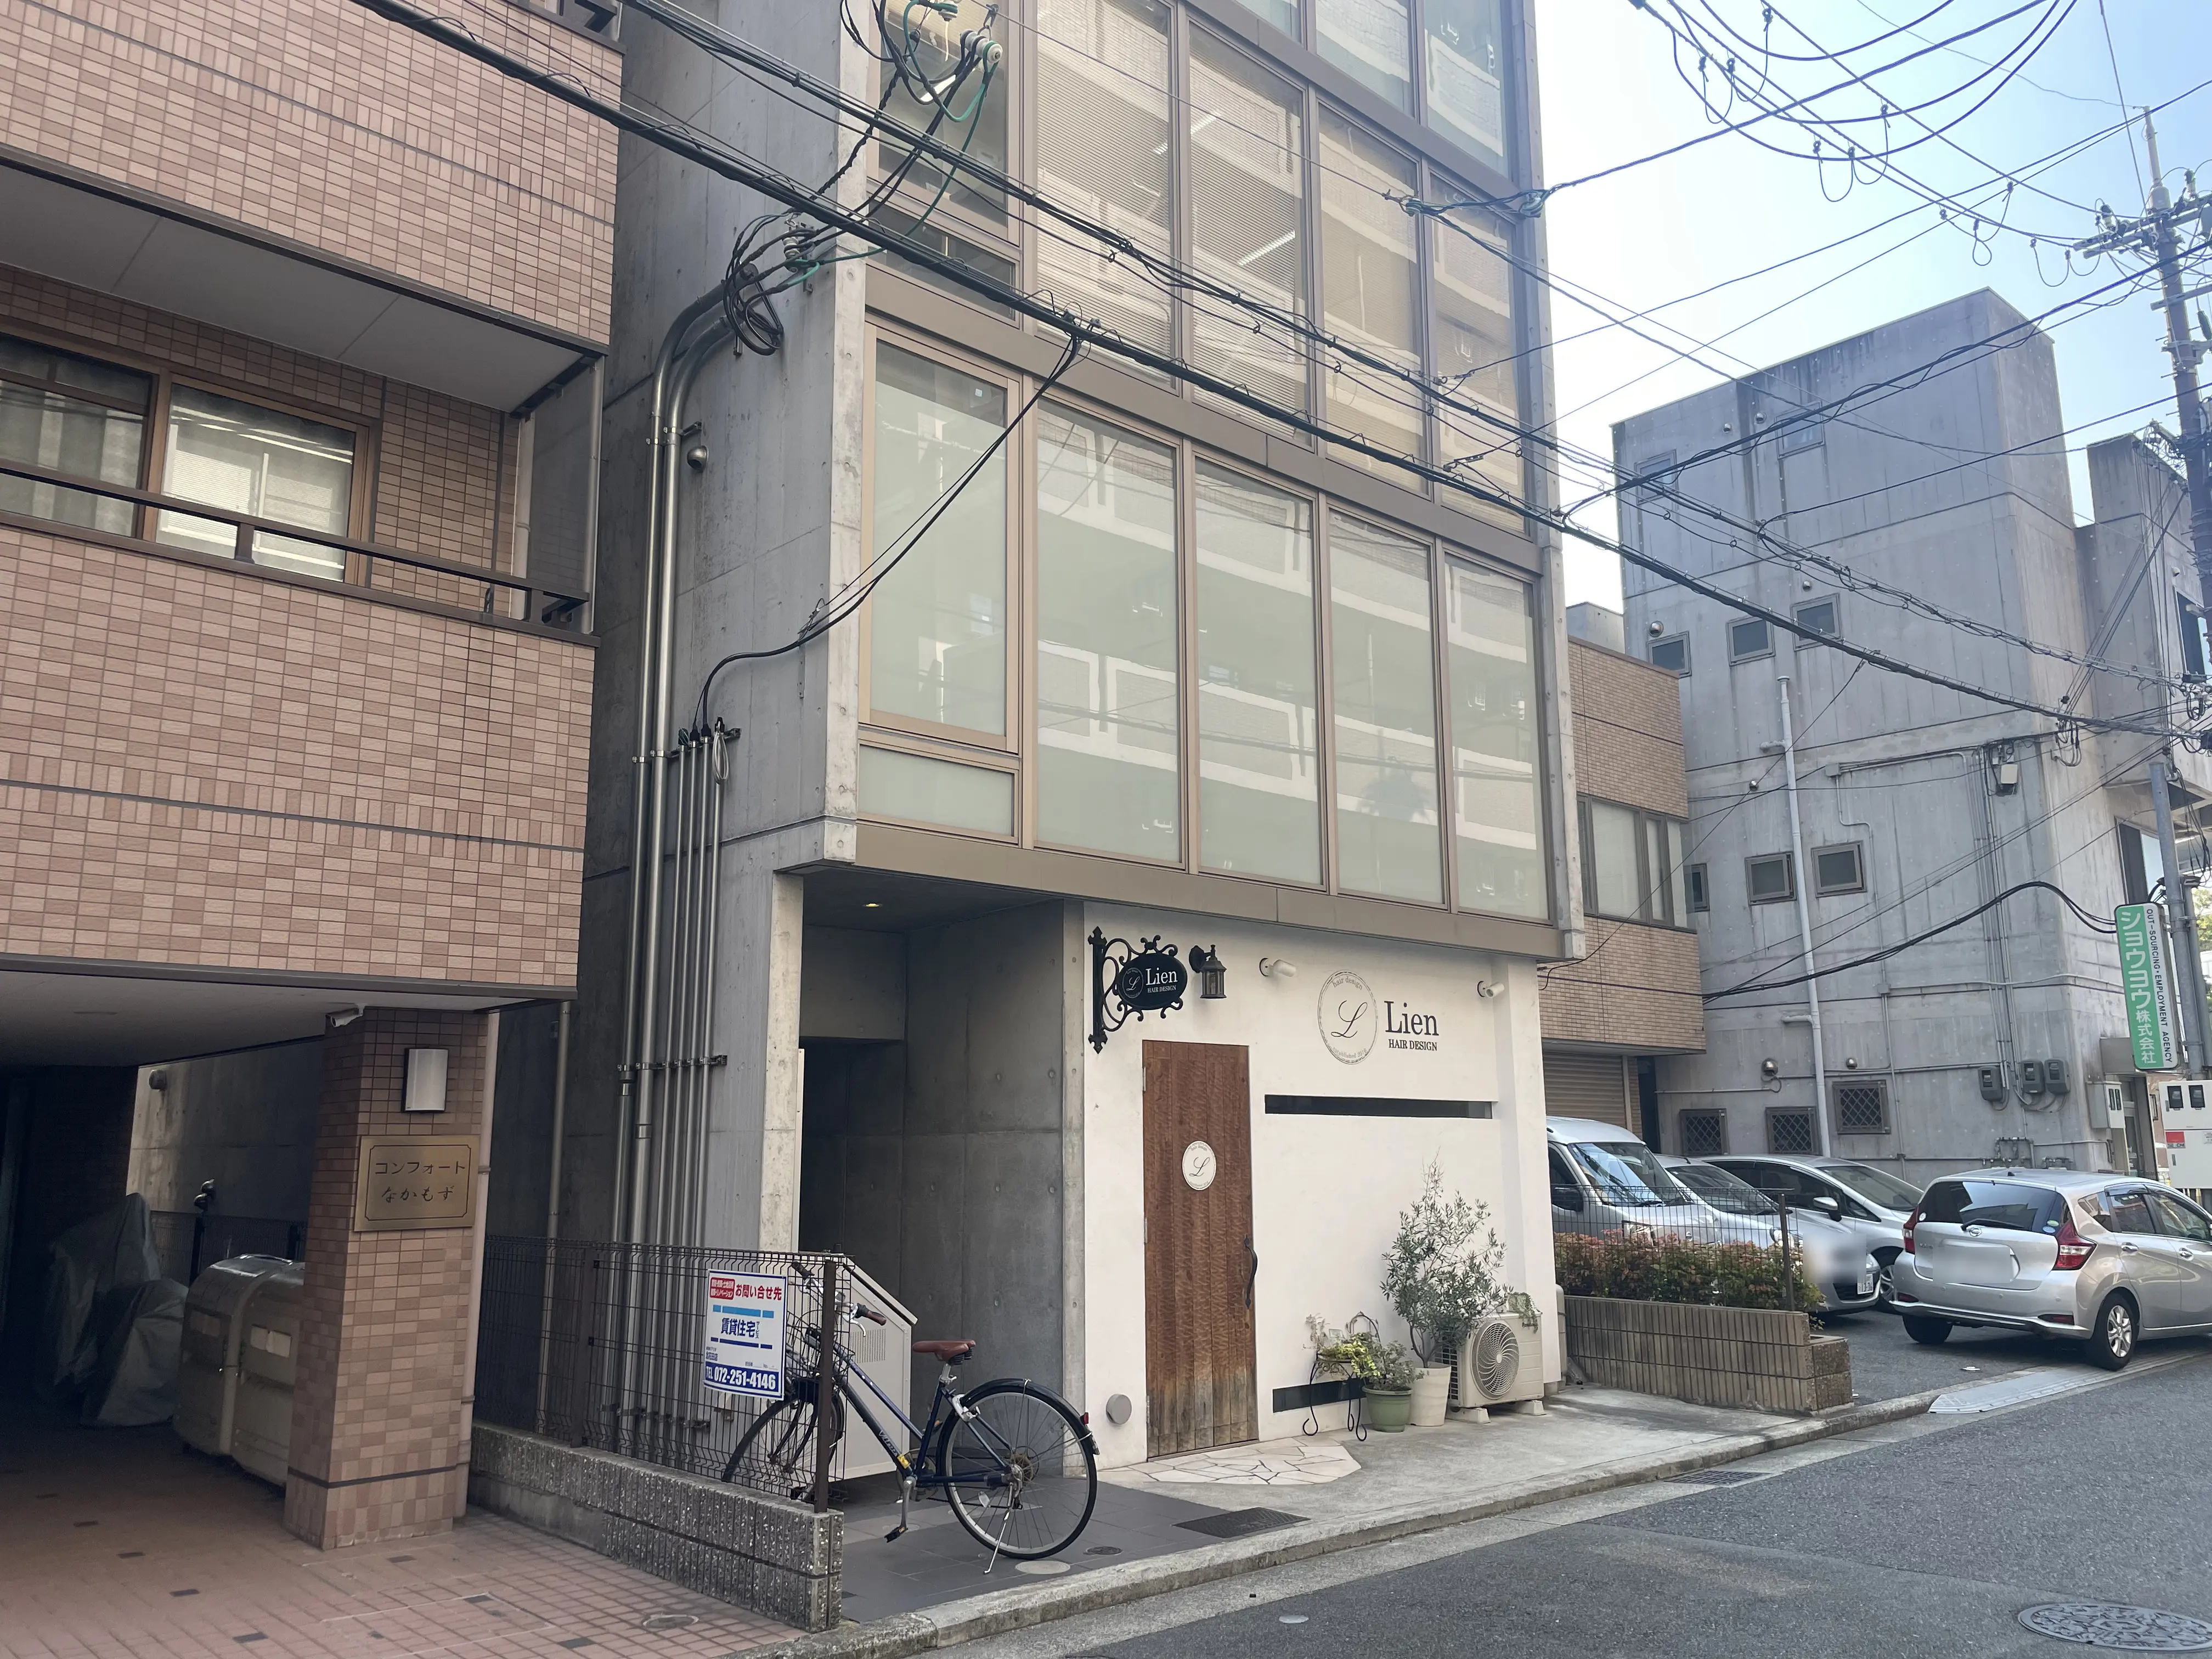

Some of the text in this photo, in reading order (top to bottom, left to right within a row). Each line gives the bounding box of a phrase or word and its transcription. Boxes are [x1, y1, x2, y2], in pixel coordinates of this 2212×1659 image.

[1146, 967, 1178, 985] Lien
[1331, 975, 1362, 990] hair design
[1384, 1000, 1440, 1036] Lien
[1389, 1039, 1437, 1051] HAIR DESIGN
[2162, 1031, 2172, 1063] AGENCY
[375, 1161, 465, 1174] コンフォート
[381, 1186, 455, 1203] なかもず
[735, 1284, 782, 1301] お問い合せ先
[721, 1318, 755, 1338] 賃貸住宅
[714, 1366, 776, 1390] 072-251-4146
